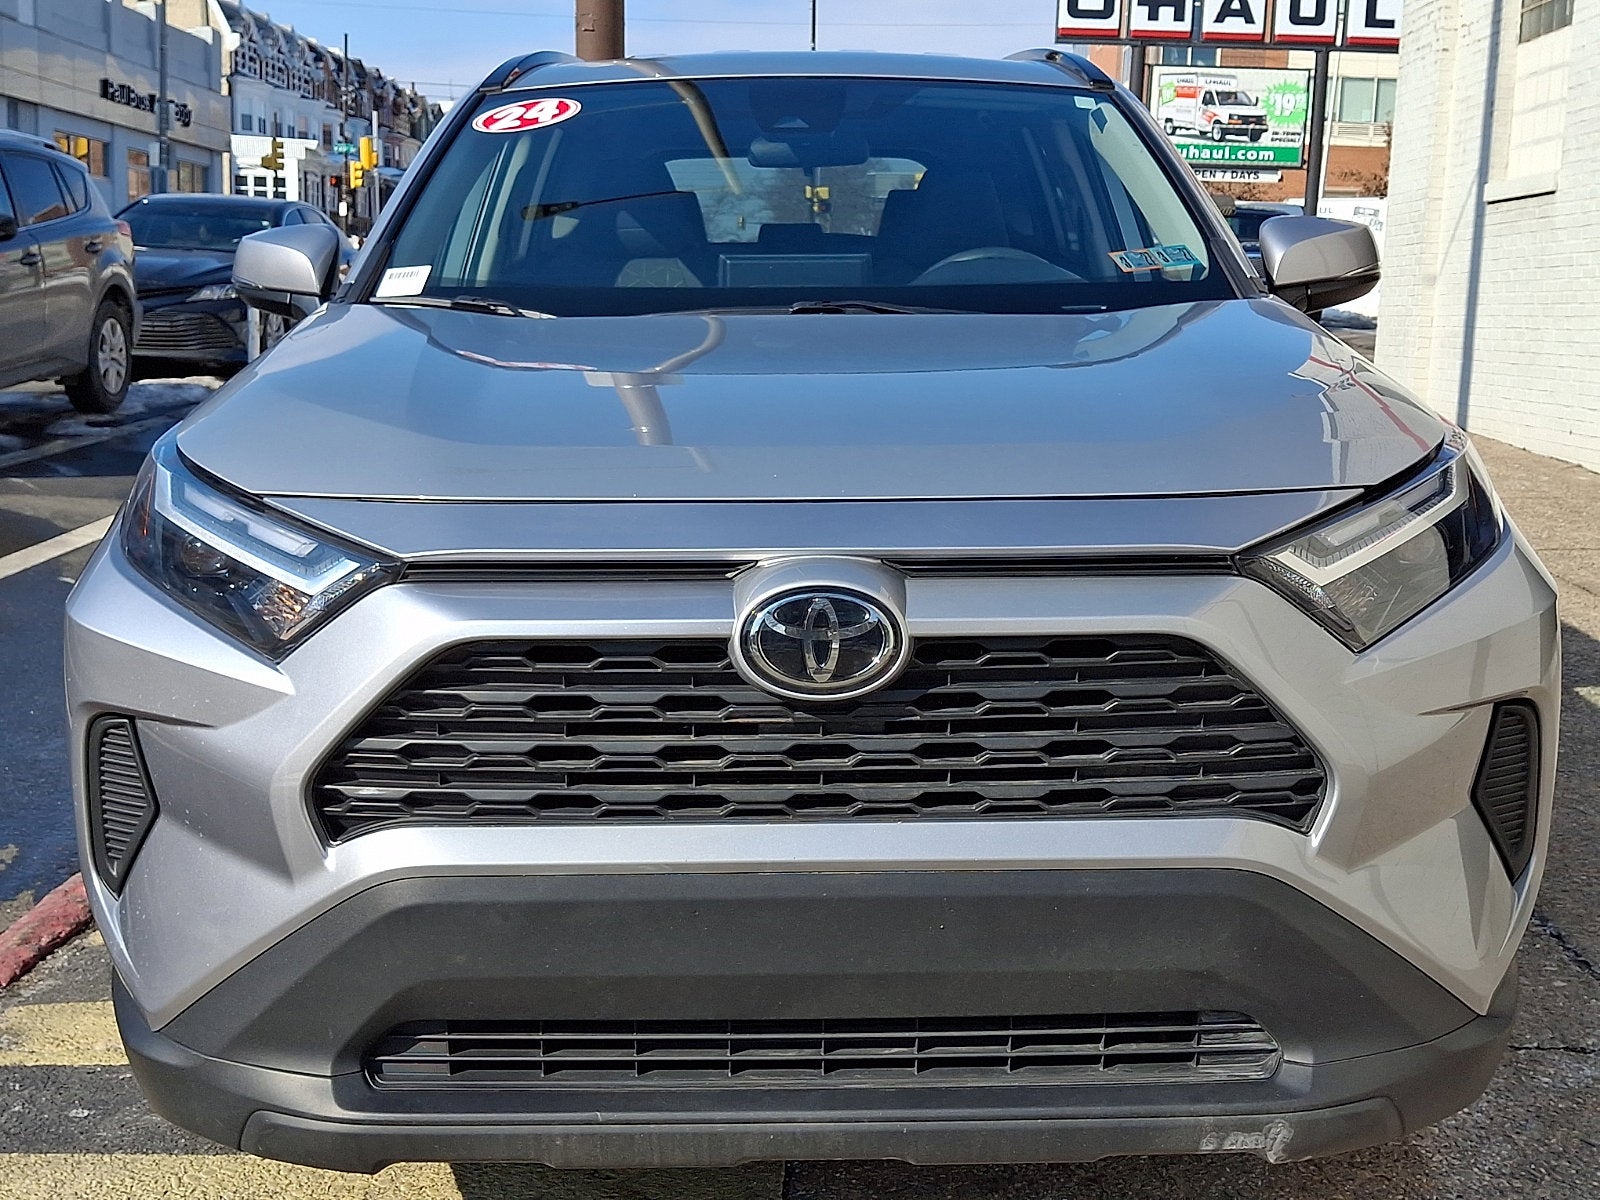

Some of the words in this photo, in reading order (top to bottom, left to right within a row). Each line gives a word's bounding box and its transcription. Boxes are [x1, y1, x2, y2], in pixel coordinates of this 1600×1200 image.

[482, 99, 561, 130] 24
[1177, 145, 1275, 161] uhaul.com
[1221, 170, 1227, 178] 7
[1230, 170, 1260, 180] DAYS
